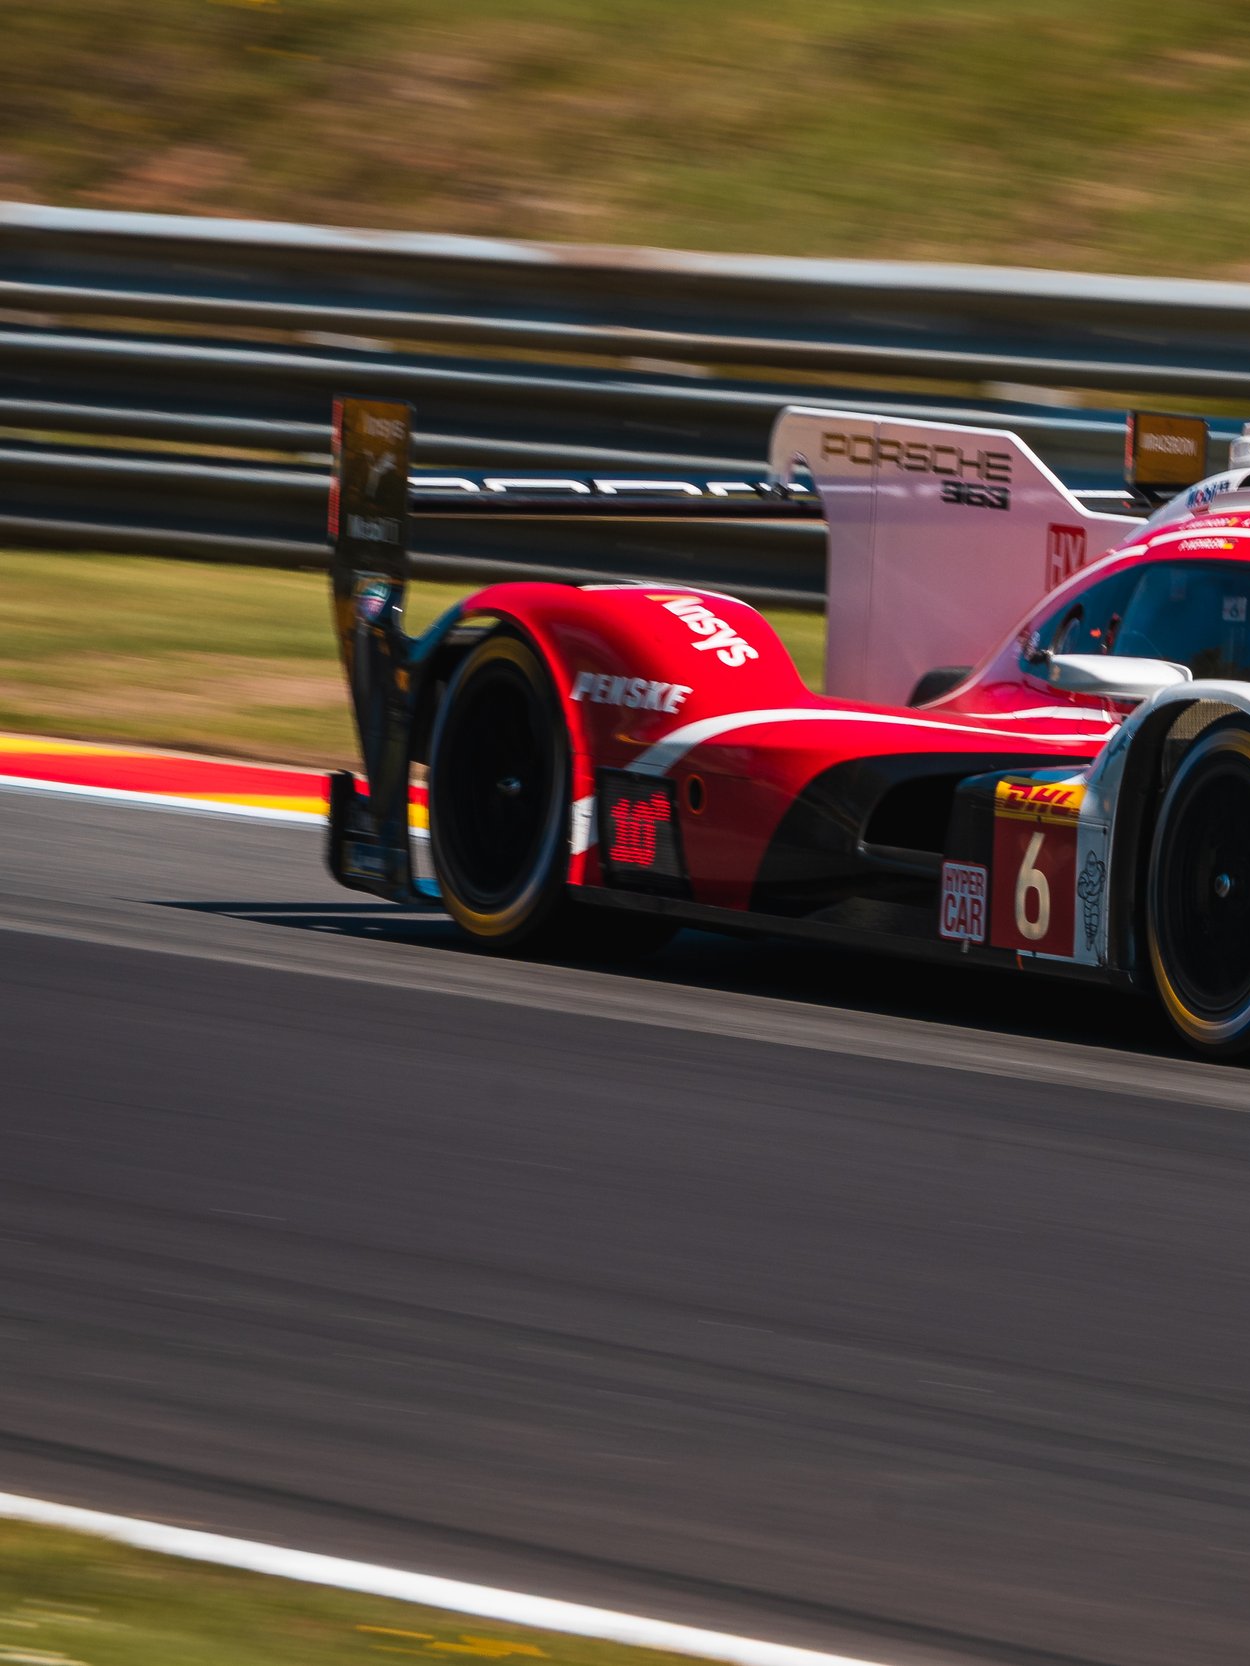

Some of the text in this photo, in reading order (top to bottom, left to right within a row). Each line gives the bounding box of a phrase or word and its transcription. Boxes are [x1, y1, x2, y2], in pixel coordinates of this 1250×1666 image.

[820, 431, 1012, 484] PORSCHE
[570, 671, 694, 715] PENSKE
[943, 866, 985, 898] HYPER
[1014, 831, 1051, 941] 6
[943, 893, 984, 937] CAR
